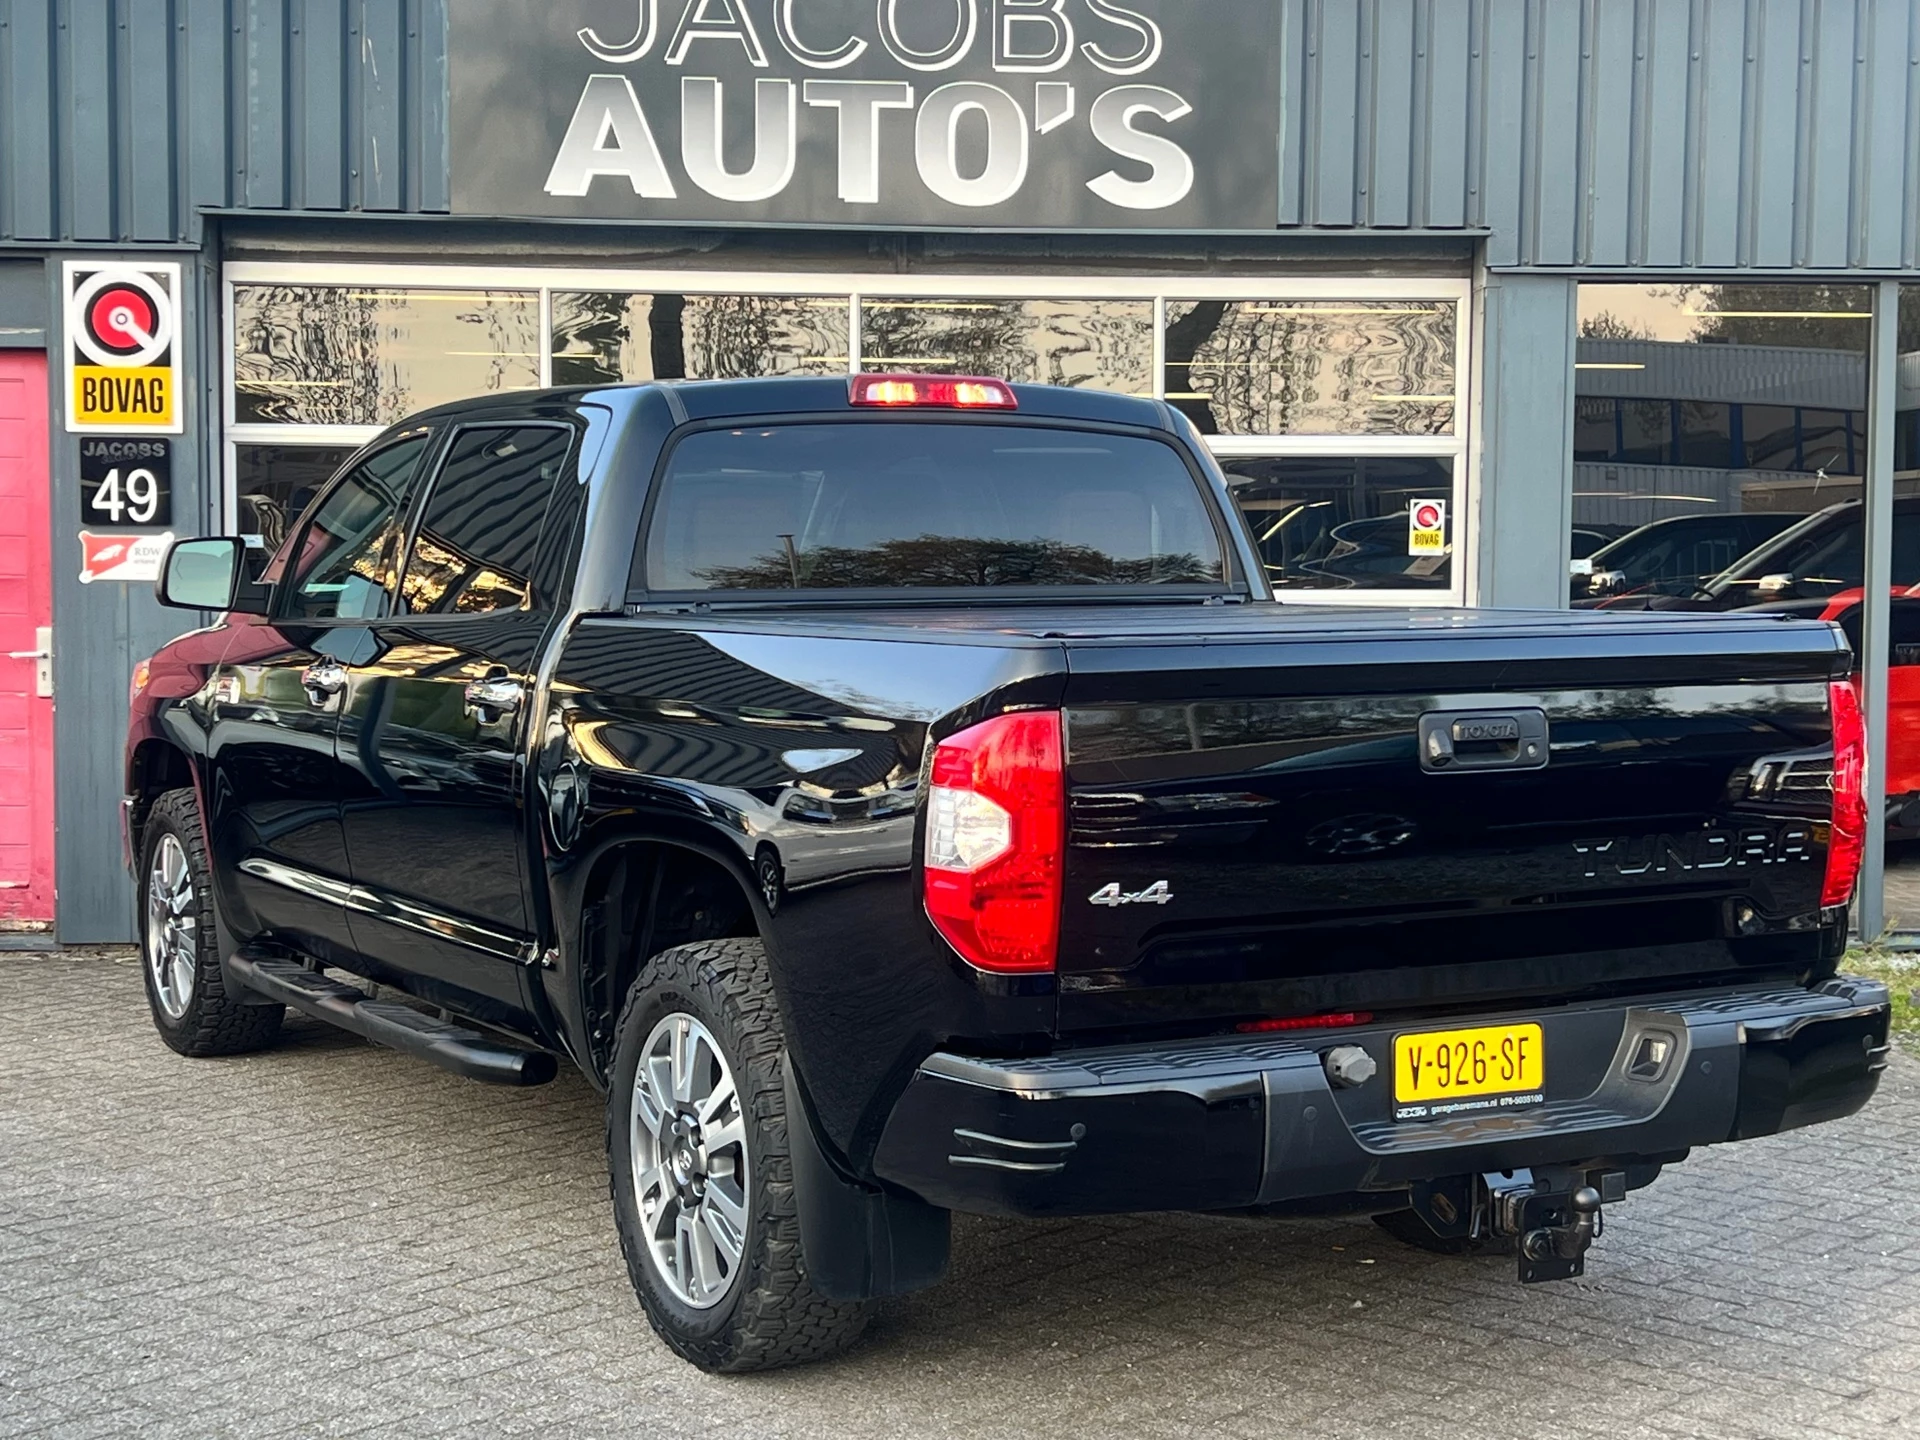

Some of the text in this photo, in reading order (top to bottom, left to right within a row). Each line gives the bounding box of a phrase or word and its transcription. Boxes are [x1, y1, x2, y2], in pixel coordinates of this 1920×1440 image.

[577, 0, 1162, 75] JACOBS
[543, 74, 1194, 210] AUTO'S
[83, 377, 164, 414] BOVAG
[82, 442, 166, 457] JACOBS
[91, 468, 158, 522] 49
[134, 547, 161, 556] RDW
[1414, 533, 1440, 546] BOVAG
[1461, 724, 1517, 738] TOYOTA
[1572, 829, 1811, 878] TUNDRA
[1409, 1036, 1529, 1091] V-926-SF
